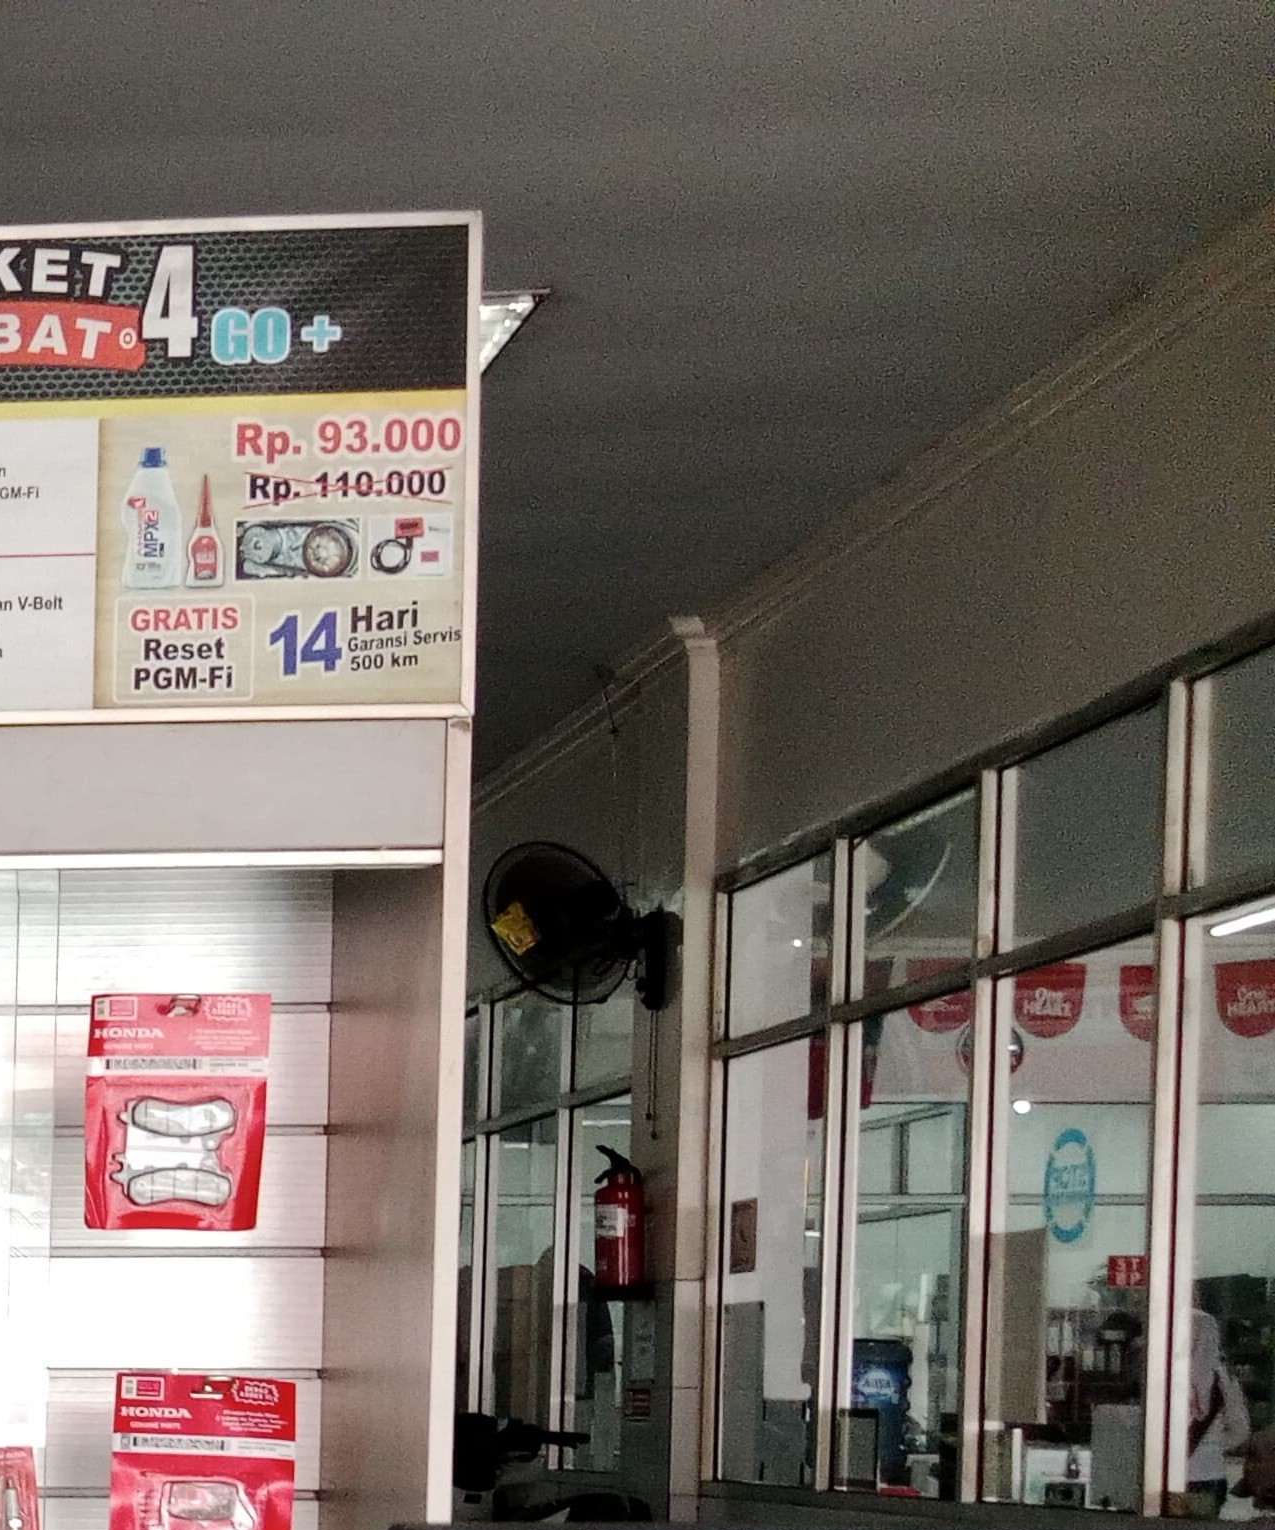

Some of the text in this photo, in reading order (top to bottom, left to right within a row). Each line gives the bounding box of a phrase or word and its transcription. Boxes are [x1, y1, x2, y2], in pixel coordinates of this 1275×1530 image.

[142, 245, 198, 358] 4
[211, 308, 289, 364] GO
[236, 418, 461, 464] Rp. 93.000
[250, 471, 445, 505] Rp. 110.000
[18, 596, 62, 610] V-Belt
[131, 607, 238, 632] GRATIS
[144, 639, 224, 661] Reset
[270, 602, 418, 676] 14 Hari
[348, 627, 461, 651] Garansi Servis
[350, 652, 418, 671] 500 km
[134, 667, 233, 690] PGM-Fi
[94, 1028, 164, 1038] HONDA
[121, 1406, 192, 1418] HONDA
